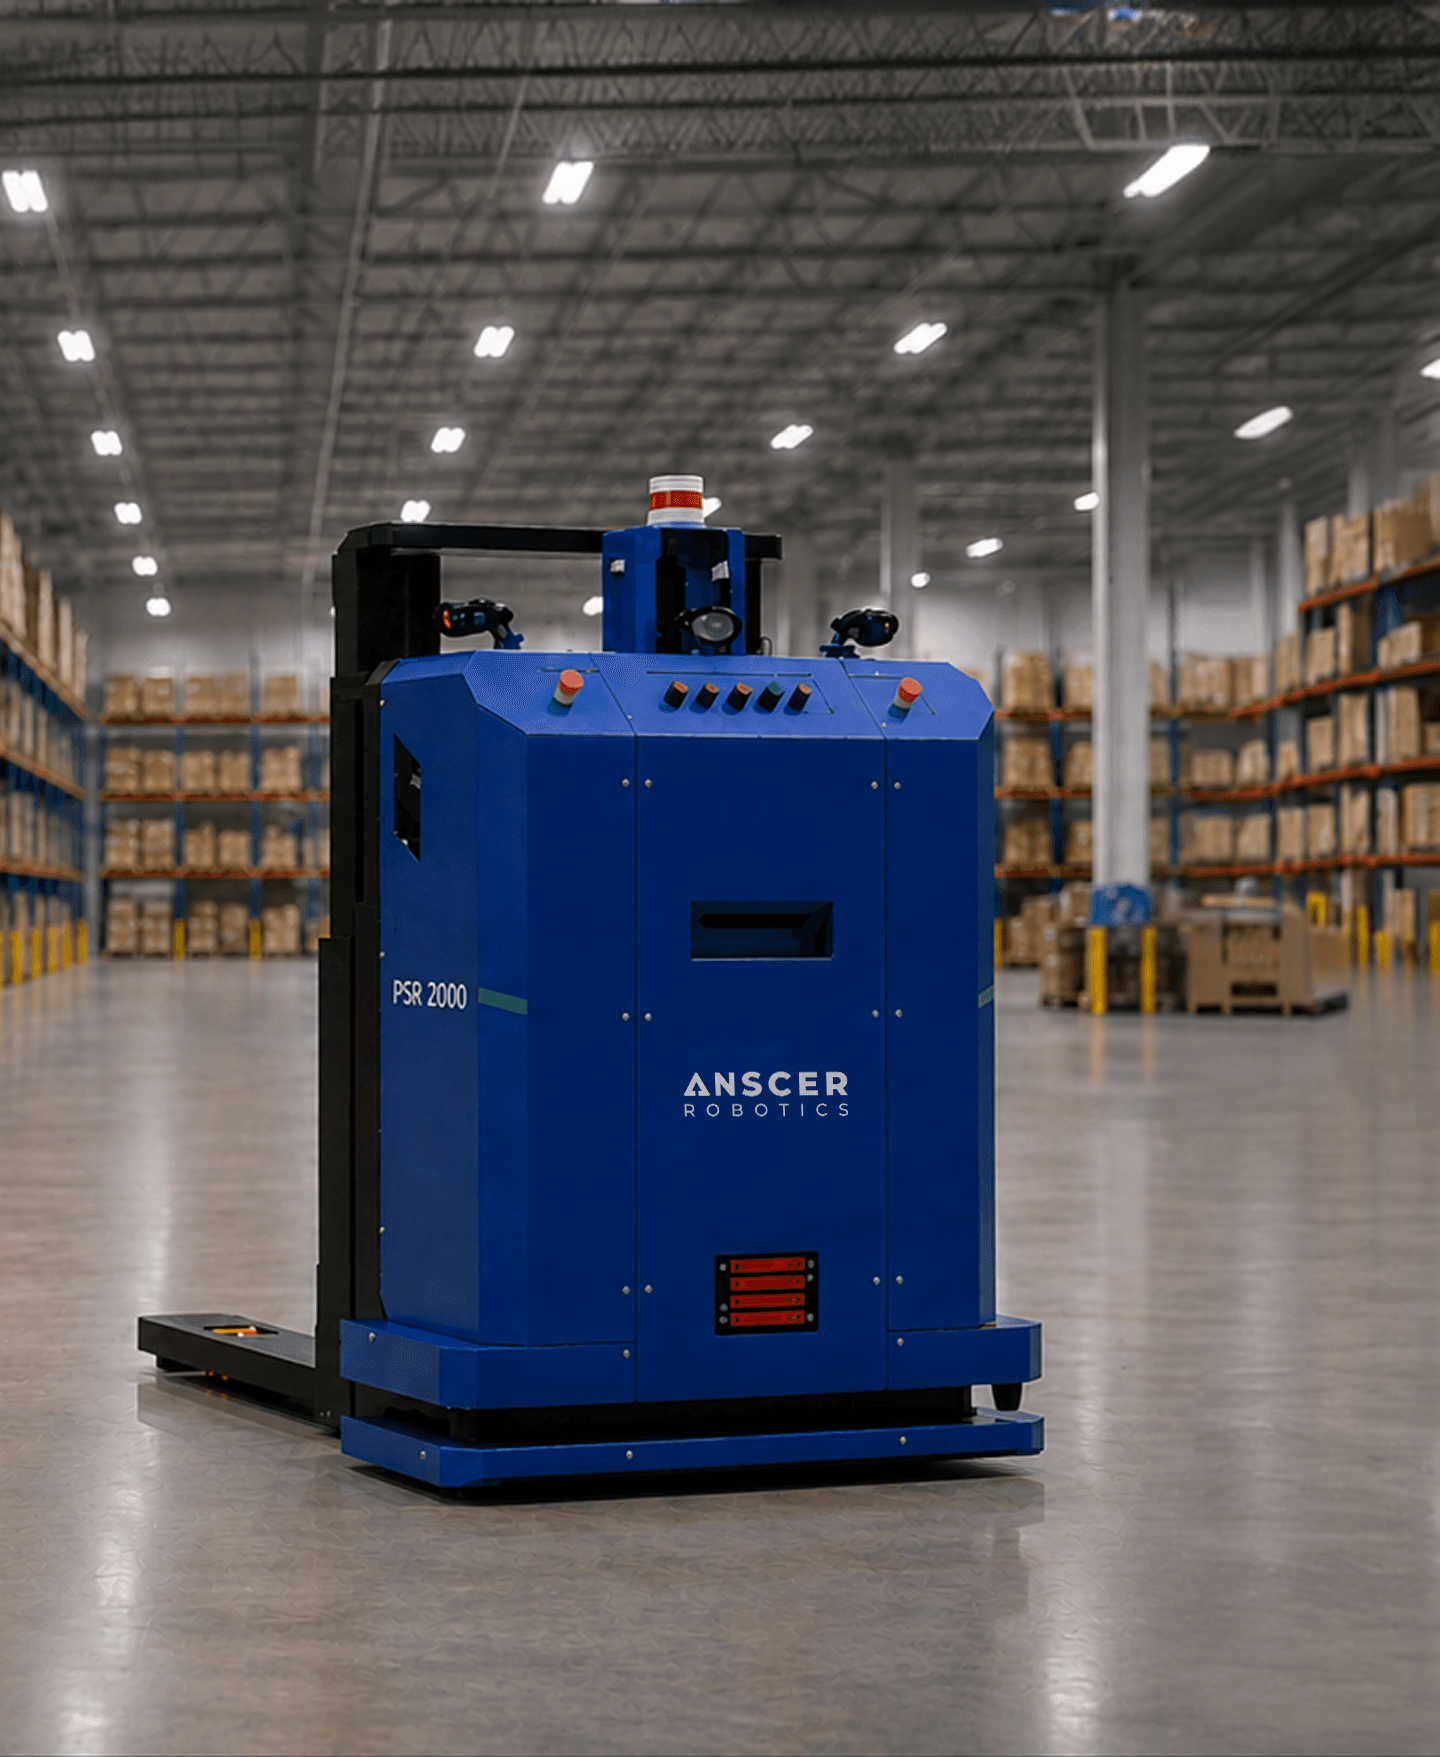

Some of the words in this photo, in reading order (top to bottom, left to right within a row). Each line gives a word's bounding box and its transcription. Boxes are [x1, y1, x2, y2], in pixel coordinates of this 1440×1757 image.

[392, 979, 423, 1006] PSR
[426, 981, 468, 1010] 2000
[683, 1071, 849, 1097] ANSCER
[683, 1103, 849, 1118] ROBOTICS
